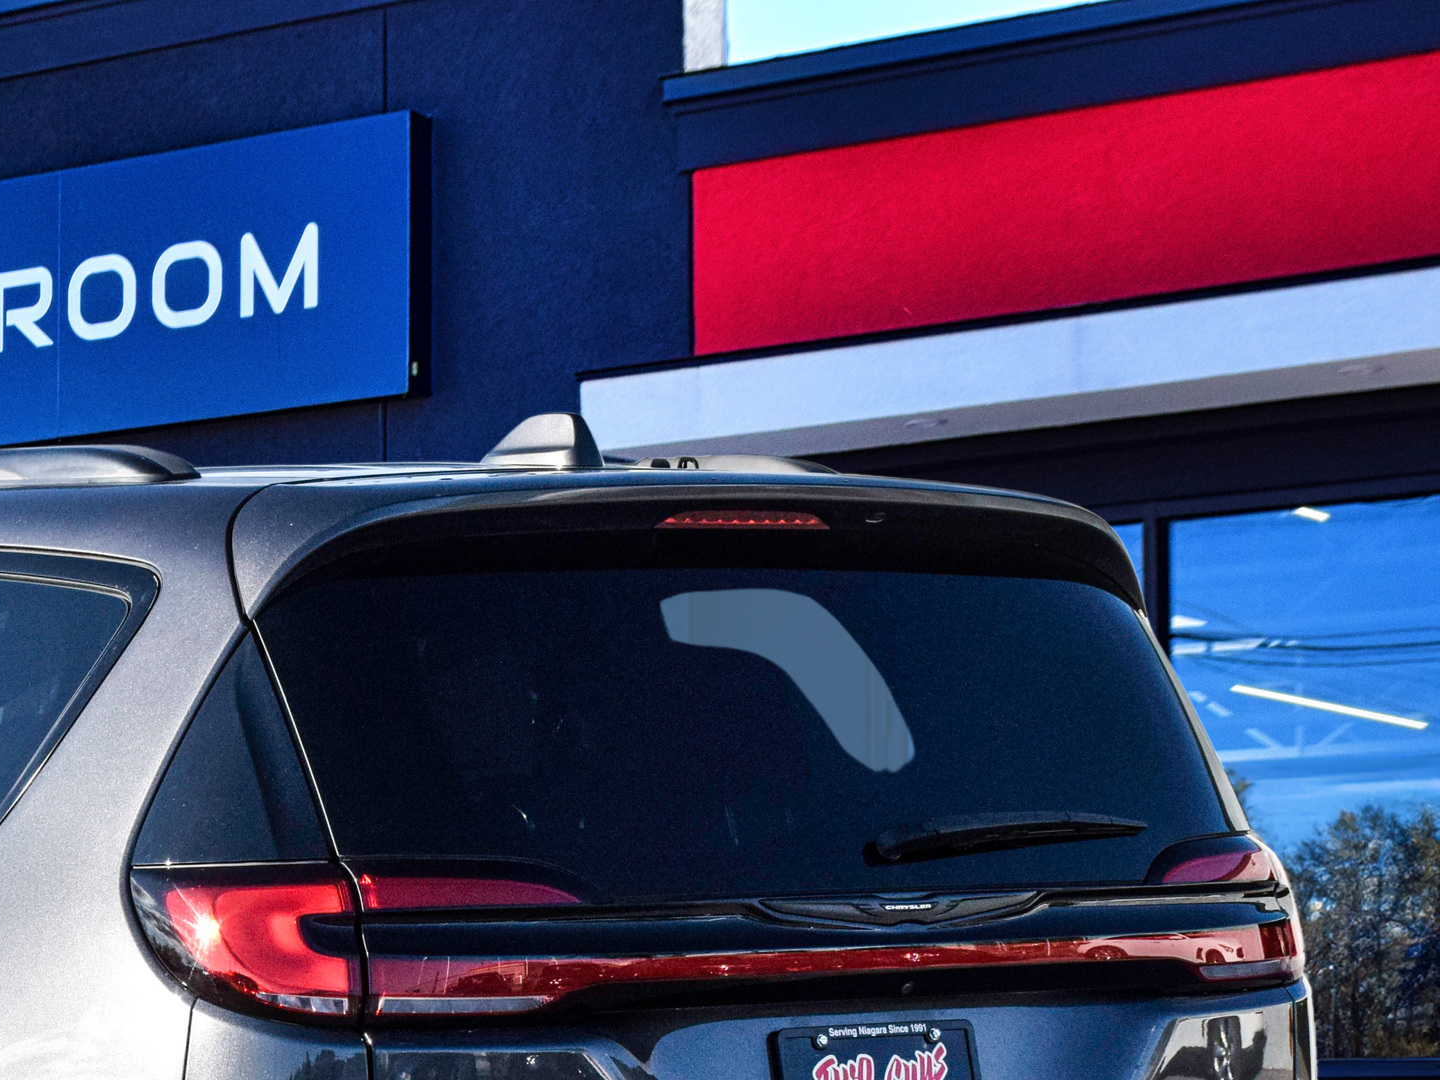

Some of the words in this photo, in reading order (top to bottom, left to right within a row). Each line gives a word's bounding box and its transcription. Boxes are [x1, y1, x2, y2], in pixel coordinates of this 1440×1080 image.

[828, 1026, 857, 1038] Serving
[858, 1025, 887, 1037] Niagara
[888, 1023, 909, 1034] Since
[910, 1022, 927, 1033] 1991
